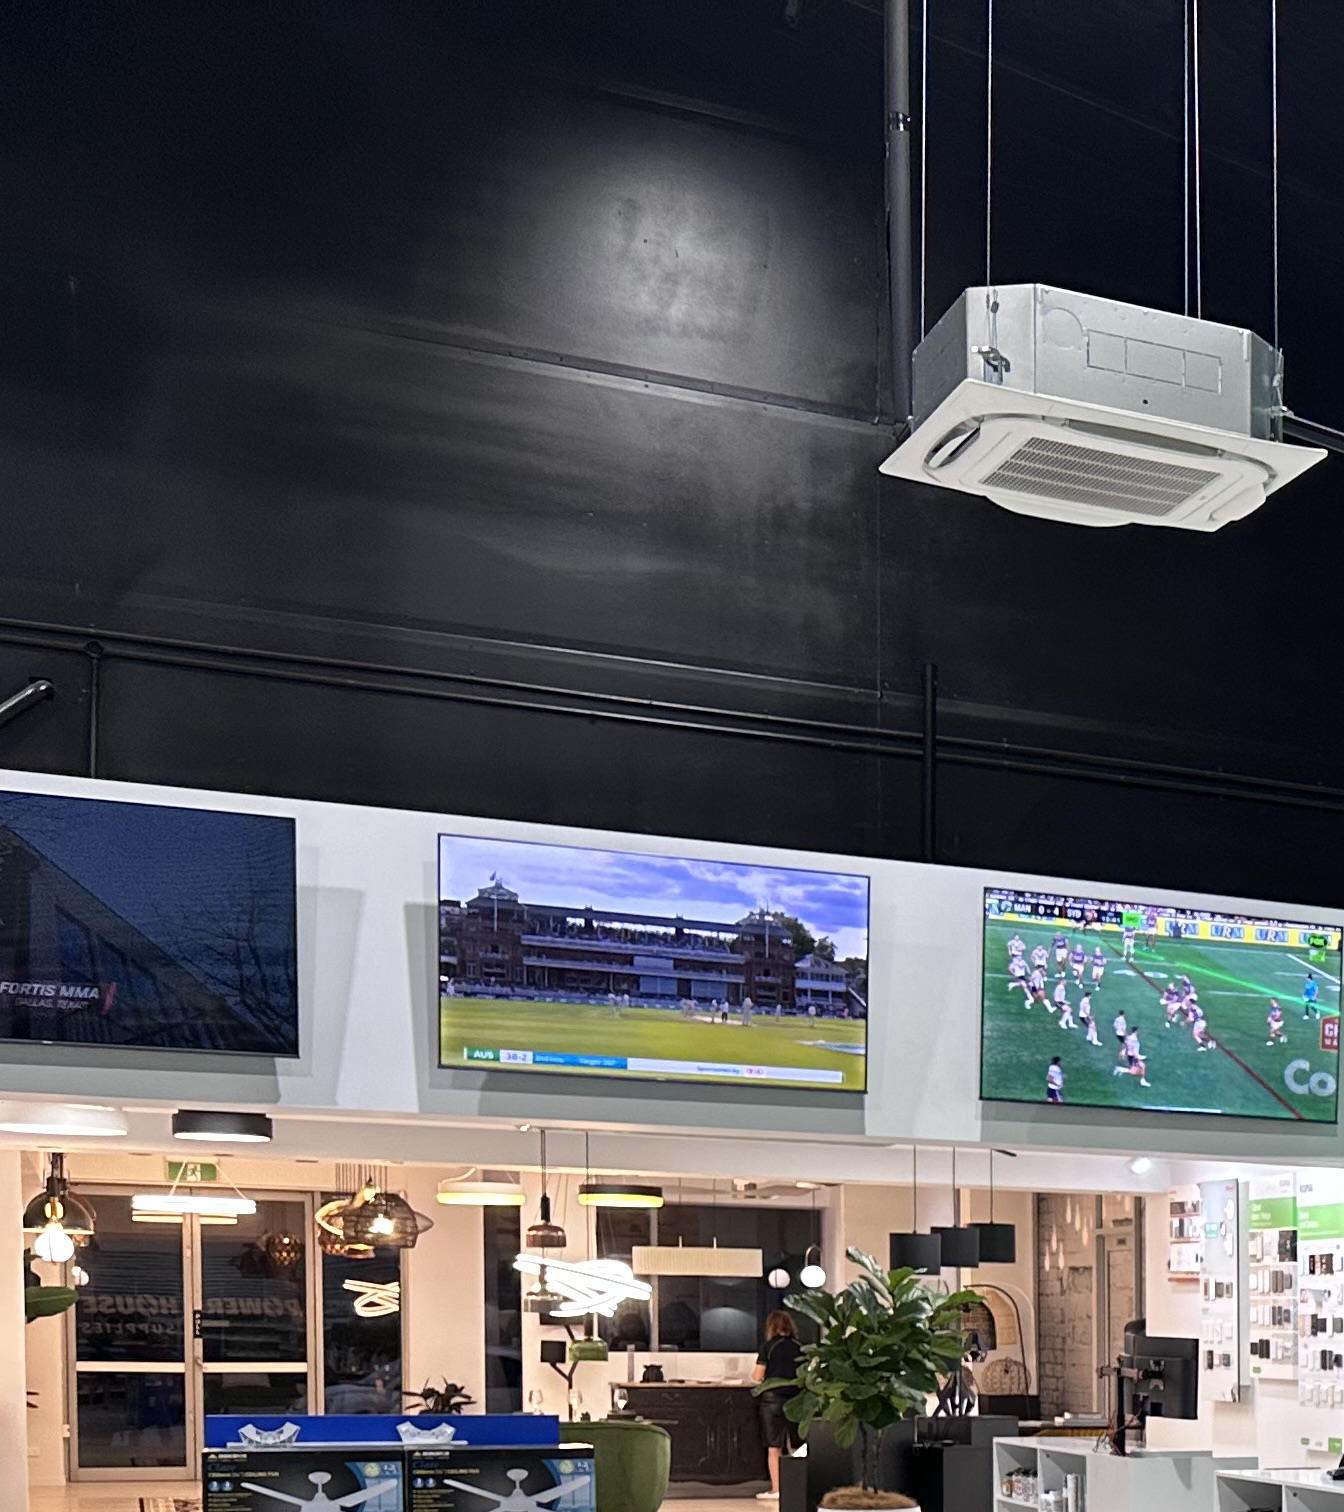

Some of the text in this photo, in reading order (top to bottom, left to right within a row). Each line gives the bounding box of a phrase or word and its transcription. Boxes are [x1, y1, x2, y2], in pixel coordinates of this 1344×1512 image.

[1210, 924, 1245, 939] URM
[1255, 928, 1289, 944] URM
[0, 981, 99, 999] FORTIS MMA
